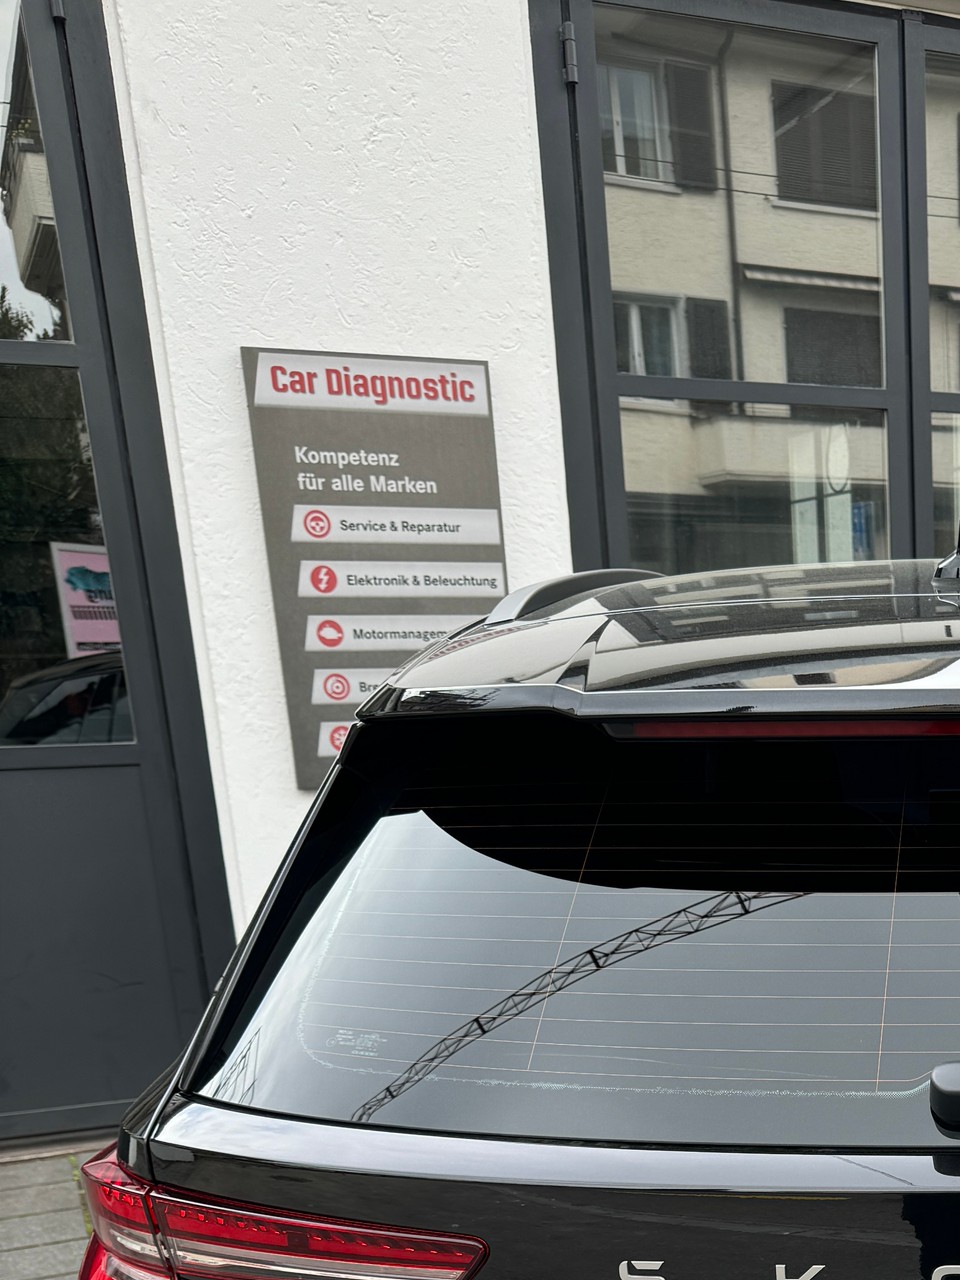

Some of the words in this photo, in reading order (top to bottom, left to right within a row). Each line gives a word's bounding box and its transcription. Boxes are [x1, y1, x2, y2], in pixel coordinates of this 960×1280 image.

[270, 365, 318, 395] Car
[325, 366, 475, 406] Diagnostic
[294, 446, 400, 468] Kompetenz
[297, 473, 325, 491] für
[331, 474, 365, 492] alle
[370, 475, 438, 494] Marken
[340, 519, 387, 532] Service
[389, 521, 398, 532] &
[401, 521, 461, 534] Reparatur
[346, 575, 410, 586] Elektronik
[412, 575, 421, 586] &
[423, 576, 498, 589] Beleuchtung
